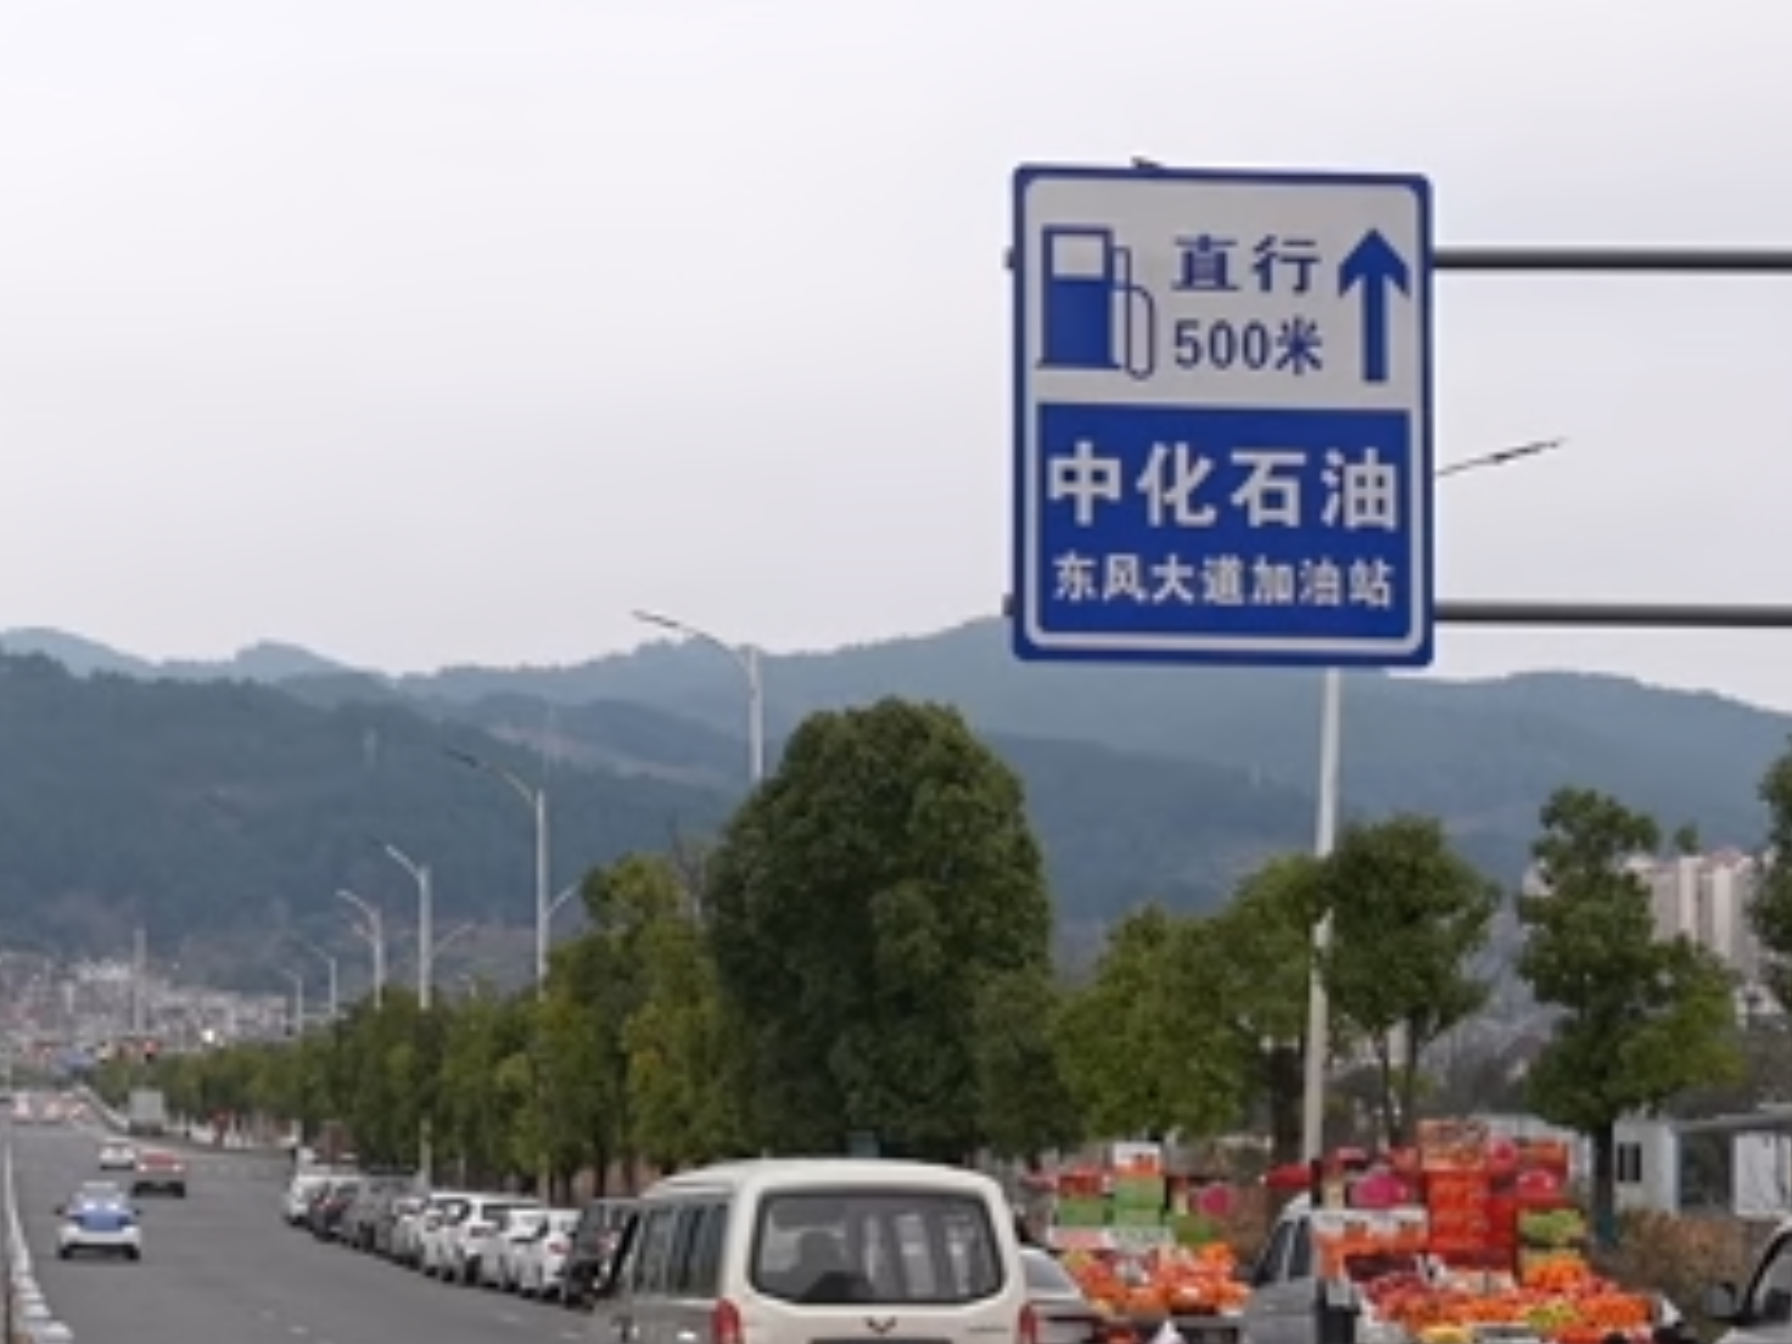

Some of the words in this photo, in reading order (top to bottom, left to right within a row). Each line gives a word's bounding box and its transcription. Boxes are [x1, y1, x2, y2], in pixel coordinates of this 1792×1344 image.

[1170, 233, 1320, 294] 直行
[1172, 316, 1323, 376] 500米
[1047, 439, 1398, 532] 中化石油
[1052, 553, 1394, 609] 东风大道加油站
